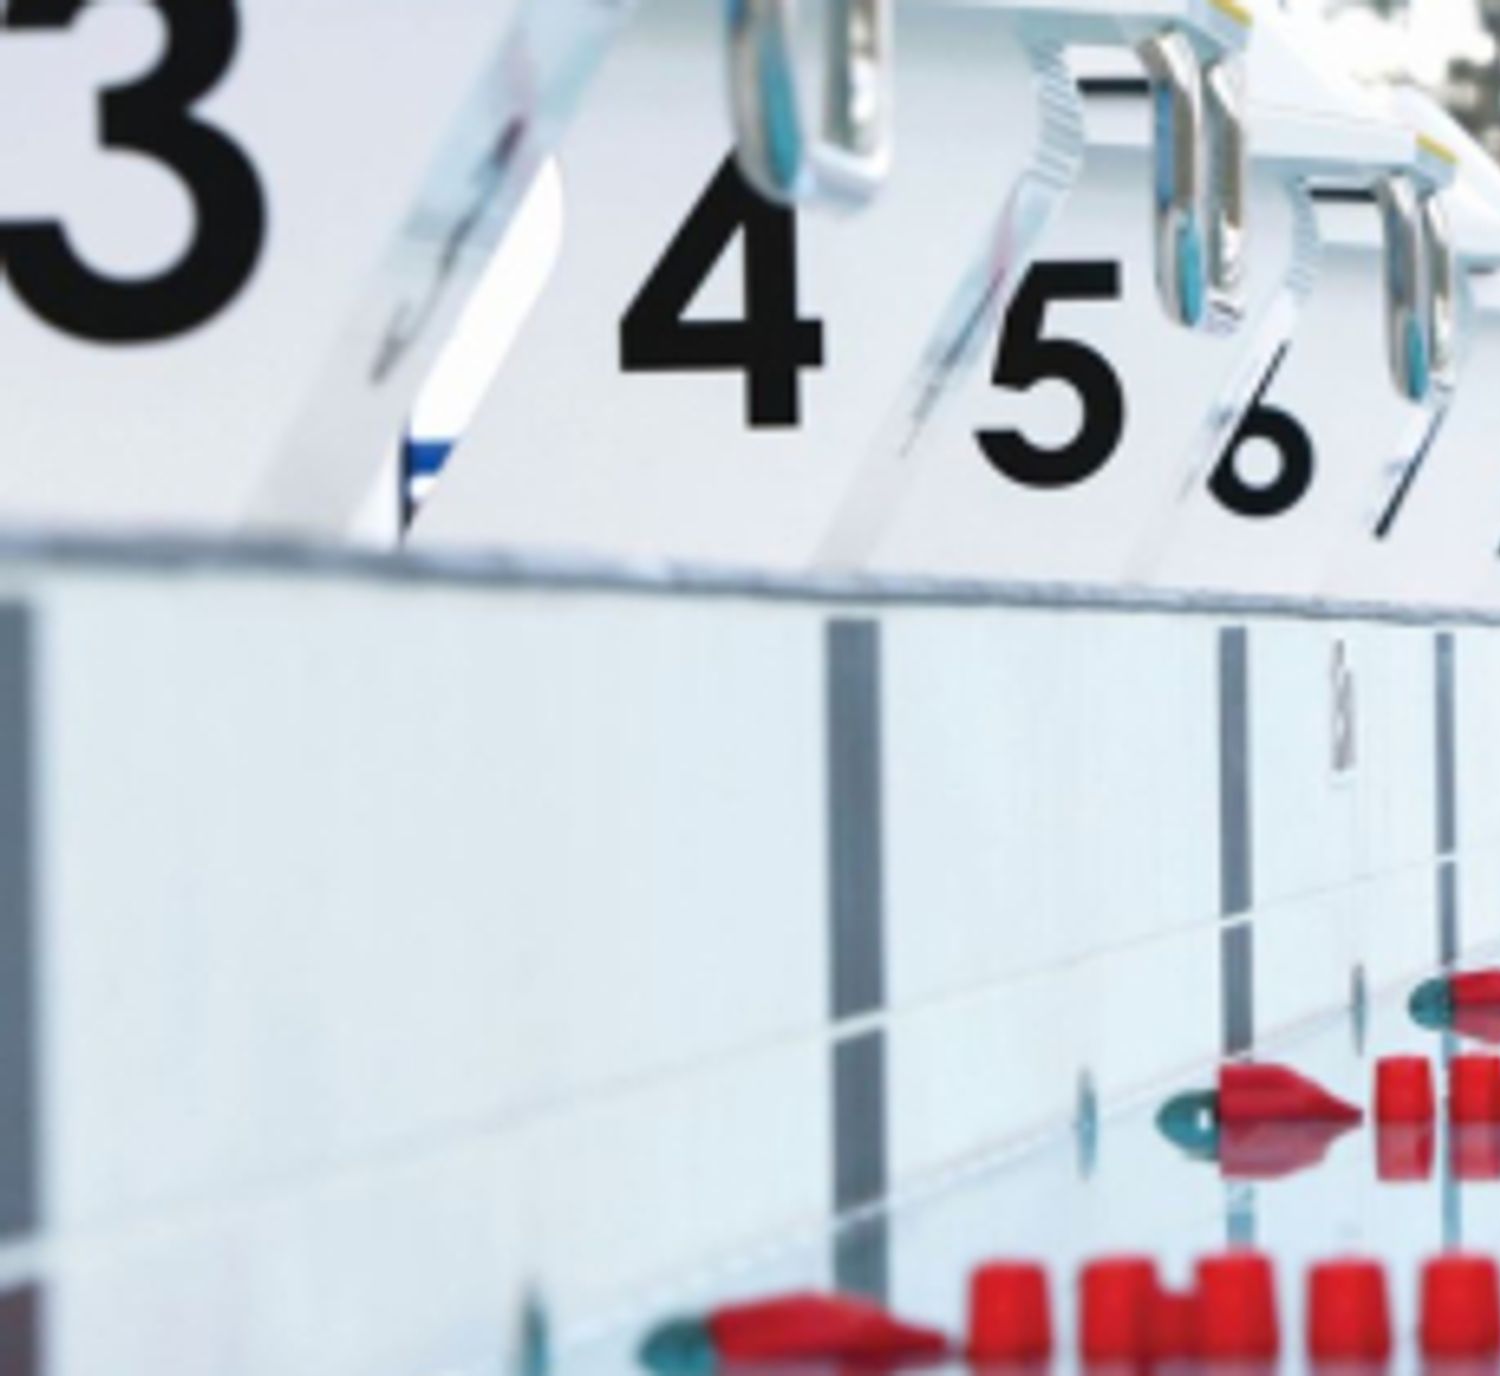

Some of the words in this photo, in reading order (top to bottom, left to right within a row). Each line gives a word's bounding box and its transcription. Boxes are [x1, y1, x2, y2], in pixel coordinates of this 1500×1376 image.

[0, 0, 266, 345] 3
[619, 150, 823, 428] 4
[976, 260, 1125, 488] 5
[1207, 340, 1313, 517] 6
